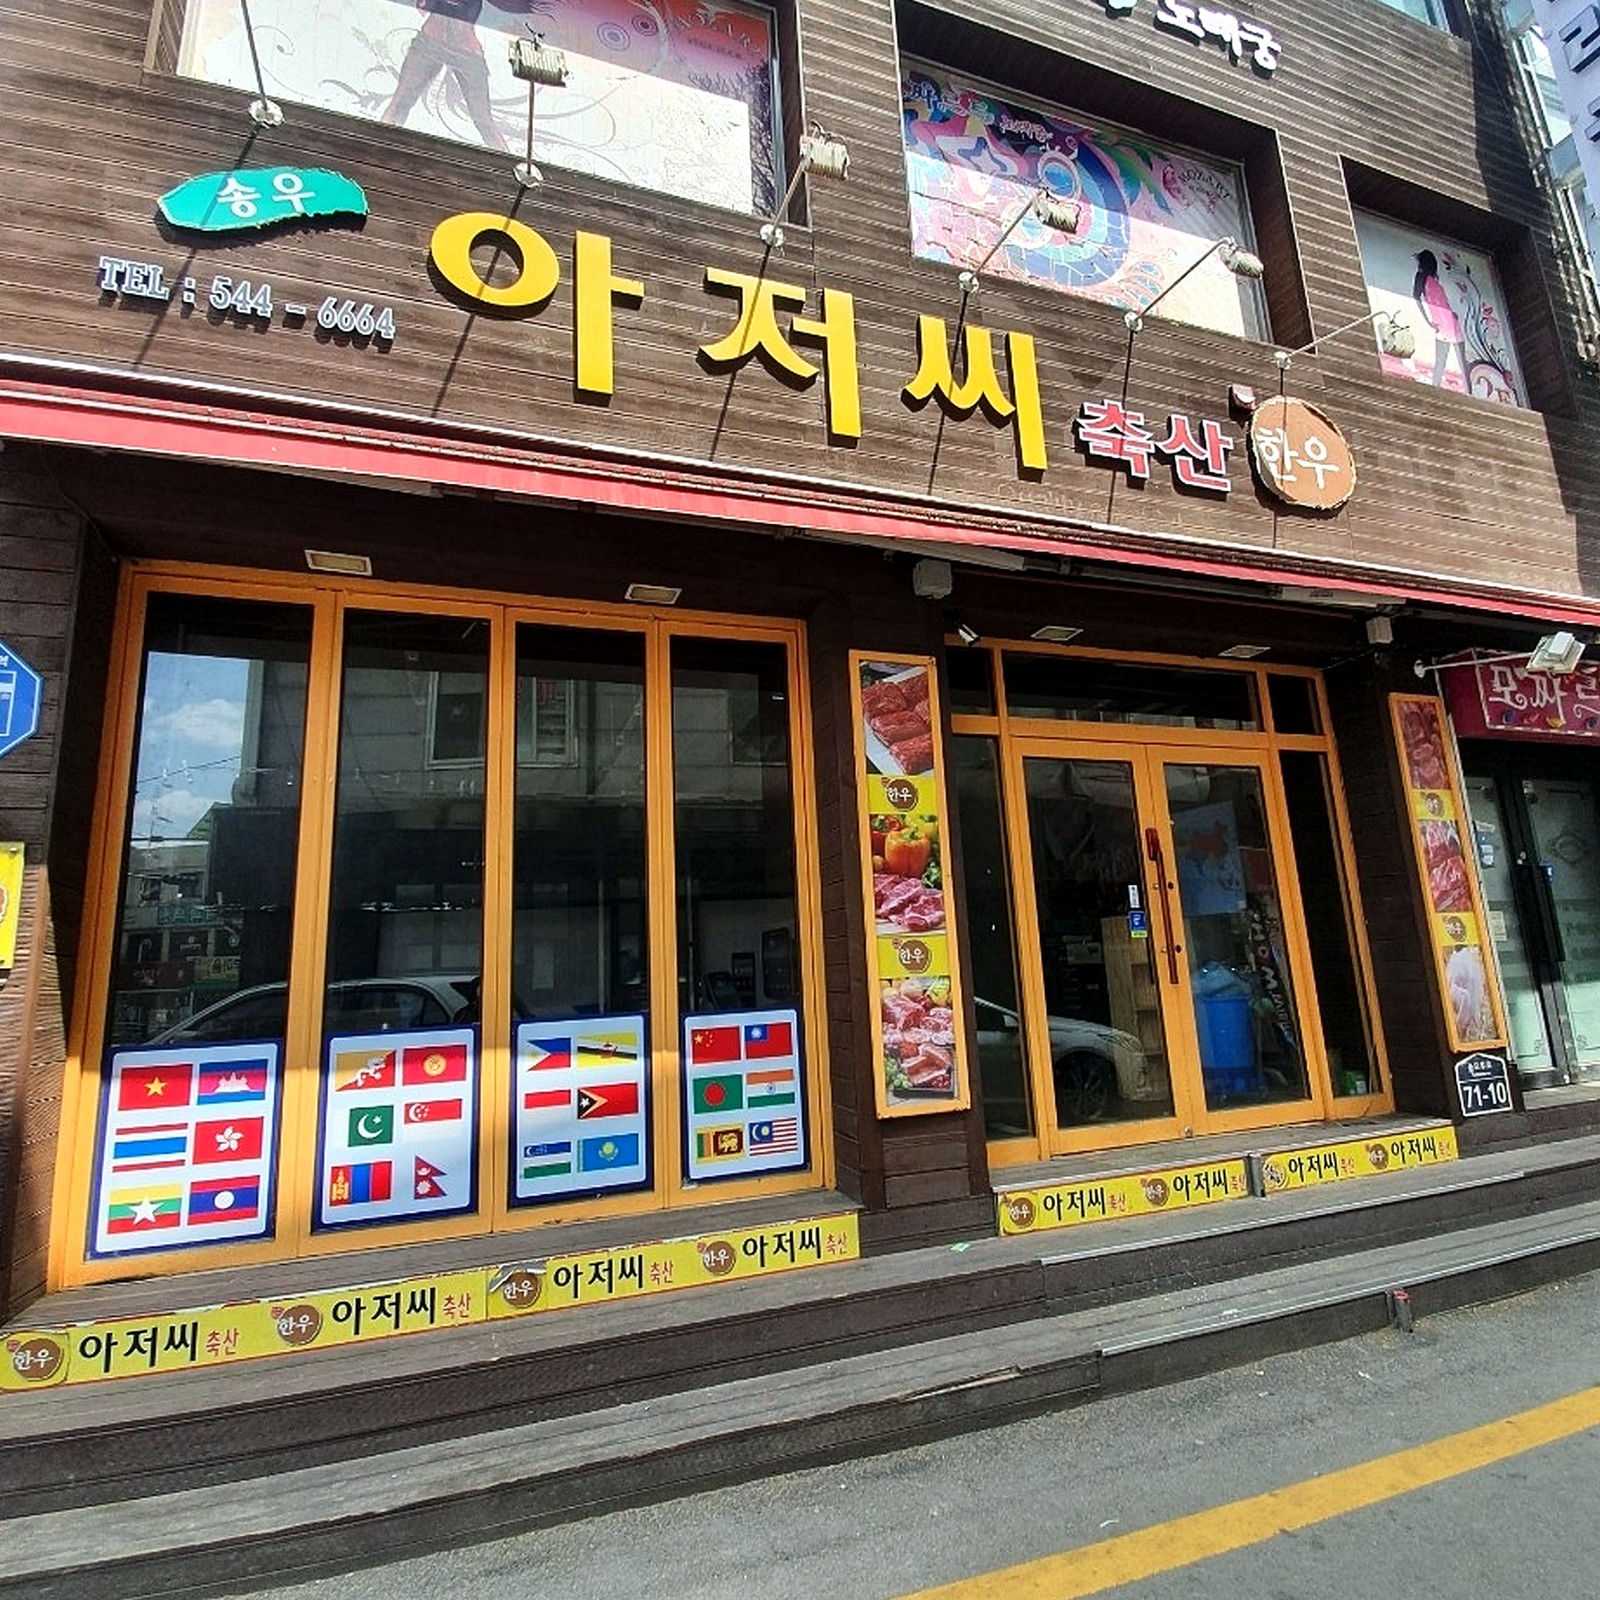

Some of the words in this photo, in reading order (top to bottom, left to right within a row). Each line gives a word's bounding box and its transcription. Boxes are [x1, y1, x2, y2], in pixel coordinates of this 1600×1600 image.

[216, 172, 317, 218] 송우
[98, 256, 169, 301] TEL
[208, 276, 273, 317] 544
[317, 297, 397, 339] 6664
[429, 211, 1048, 471] 아저씨
[1075, 399, 1238, 494] 축산
[1254, 427, 1340, 489] 한우
[887, 787, 912, 804] 한우
[899, 947, 925, 965] 한우
[1462, 1081, 1507, 1109] 71-10
[1288, 1152, 1340, 1183] 아저씨
[1391, 1136, 1438, 1165] 아저씨
[1043, 1186, 1106, 1222] 아저씨
[1172, 1168, 1229, 1202] 아저씨
[503, 1279, 534, 1300] 한우
[553, 1254, 644, 1299] 아저씨
[650, 1260, 674, 1285] 축산
[703, 1248, 730, 1269] 한우
[742, 1226, 822, 1268] 아저씨
[14, 1347, 53, 1371] 한우
[79, 1321, 199, 1374] 아저씨
[206, 1327, 240, 1357] 축산
[278, 1313, 314, 1337] 한우
[332, 1287, 437, 1336] 아저씨
[443, 1292, 472, 1320] 축산
